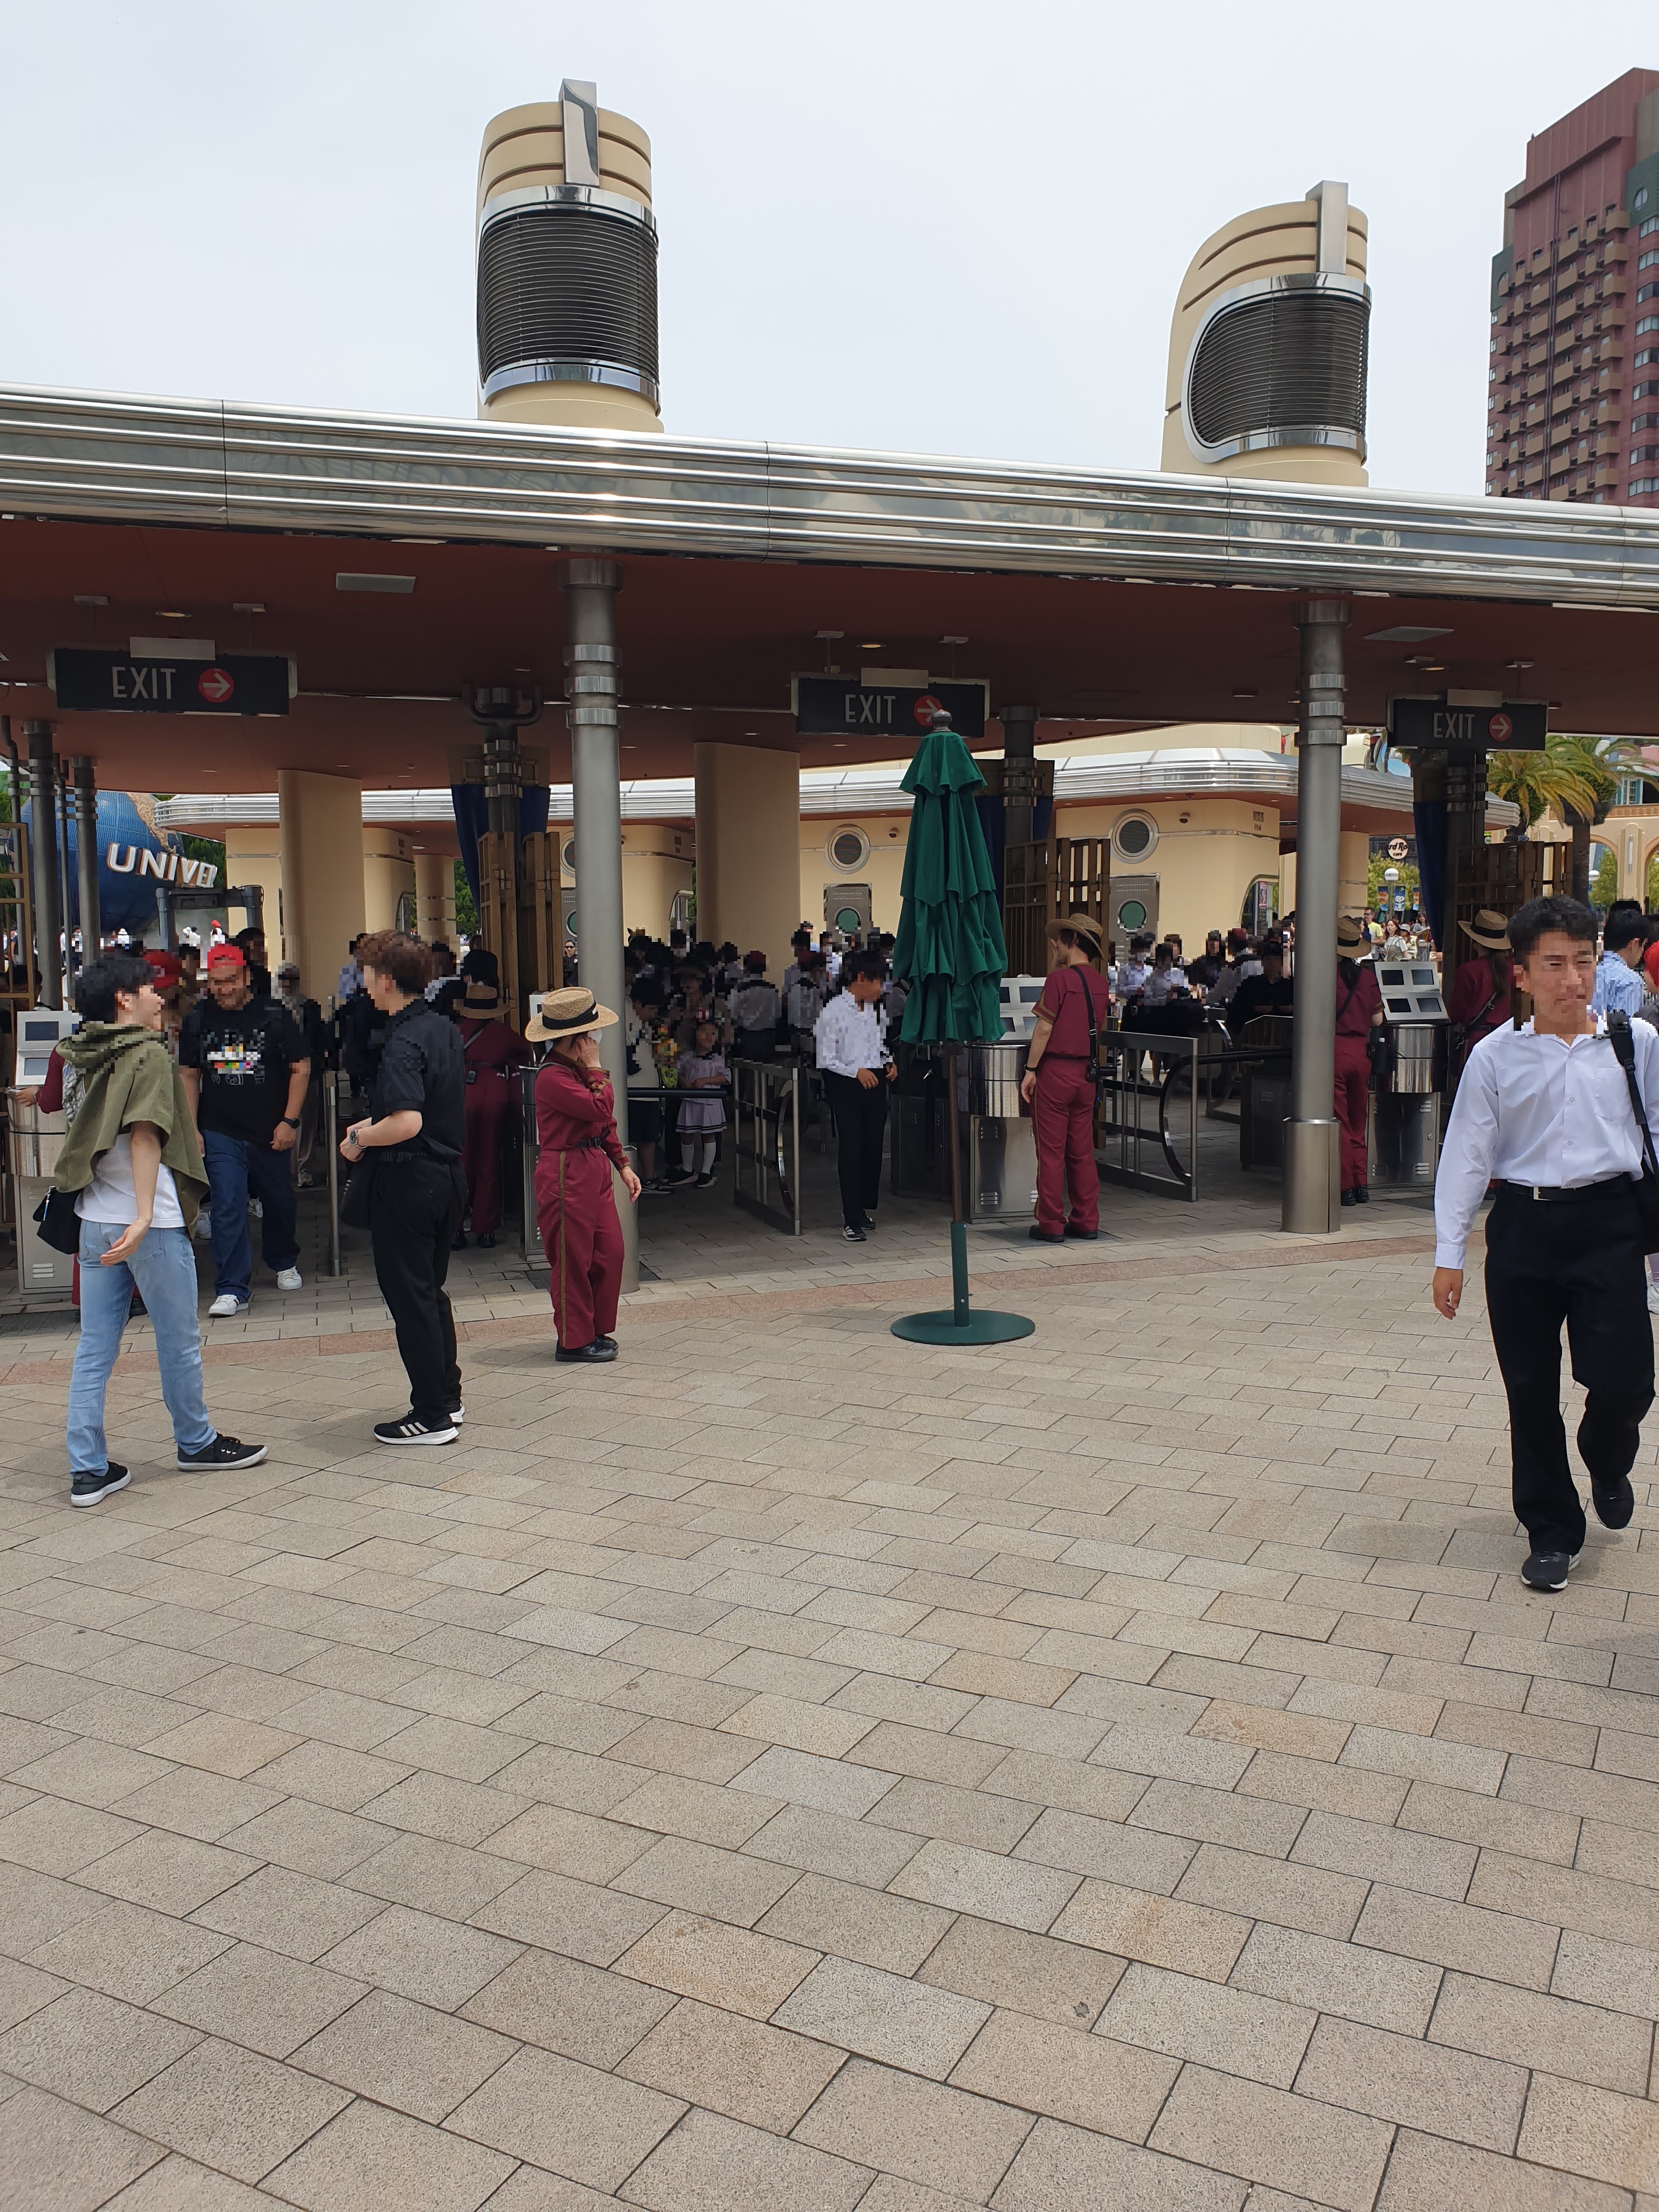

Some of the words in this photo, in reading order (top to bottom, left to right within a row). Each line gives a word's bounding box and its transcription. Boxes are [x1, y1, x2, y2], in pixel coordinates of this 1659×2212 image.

[112, 666, 176, 699] EXIT
[845, 694, 896, 724] EXIT
[1433, 712, 1475, 739] EXIT
